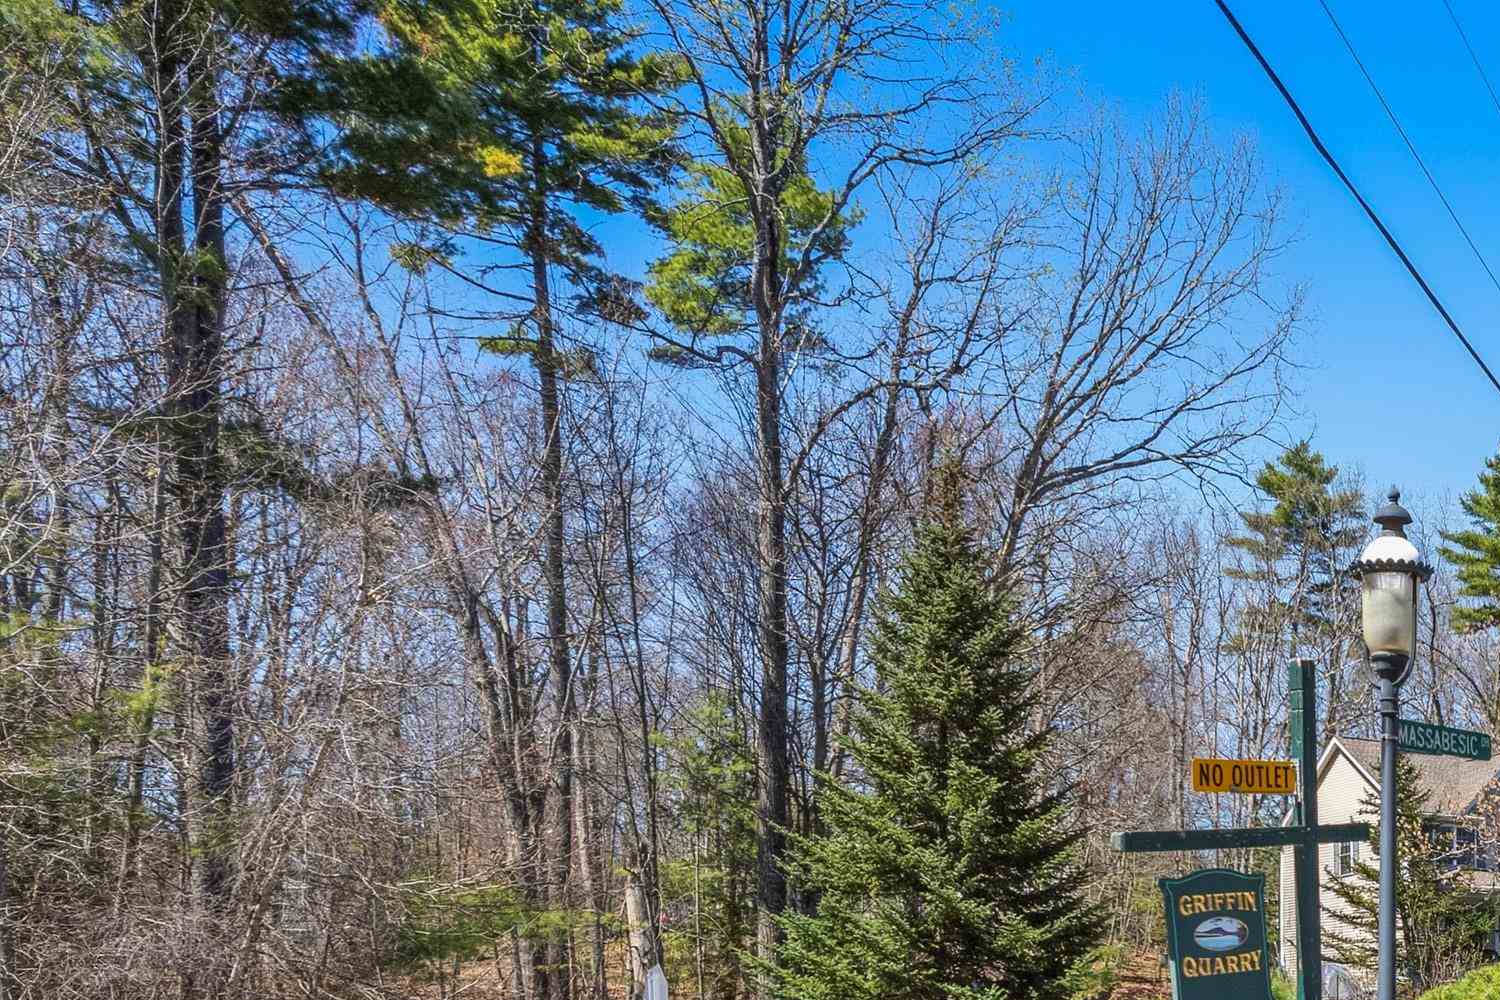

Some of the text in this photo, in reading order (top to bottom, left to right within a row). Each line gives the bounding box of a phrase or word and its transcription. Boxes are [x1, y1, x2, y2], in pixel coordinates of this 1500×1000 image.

[1398, 724, 1479, 756] MASSABESIC
[1199, 763, 1291, 788] NO OUTLET
[1179, 891, 1258, 916] GRIFFIN
[1182, 949, 1263, 978] QUARRY
